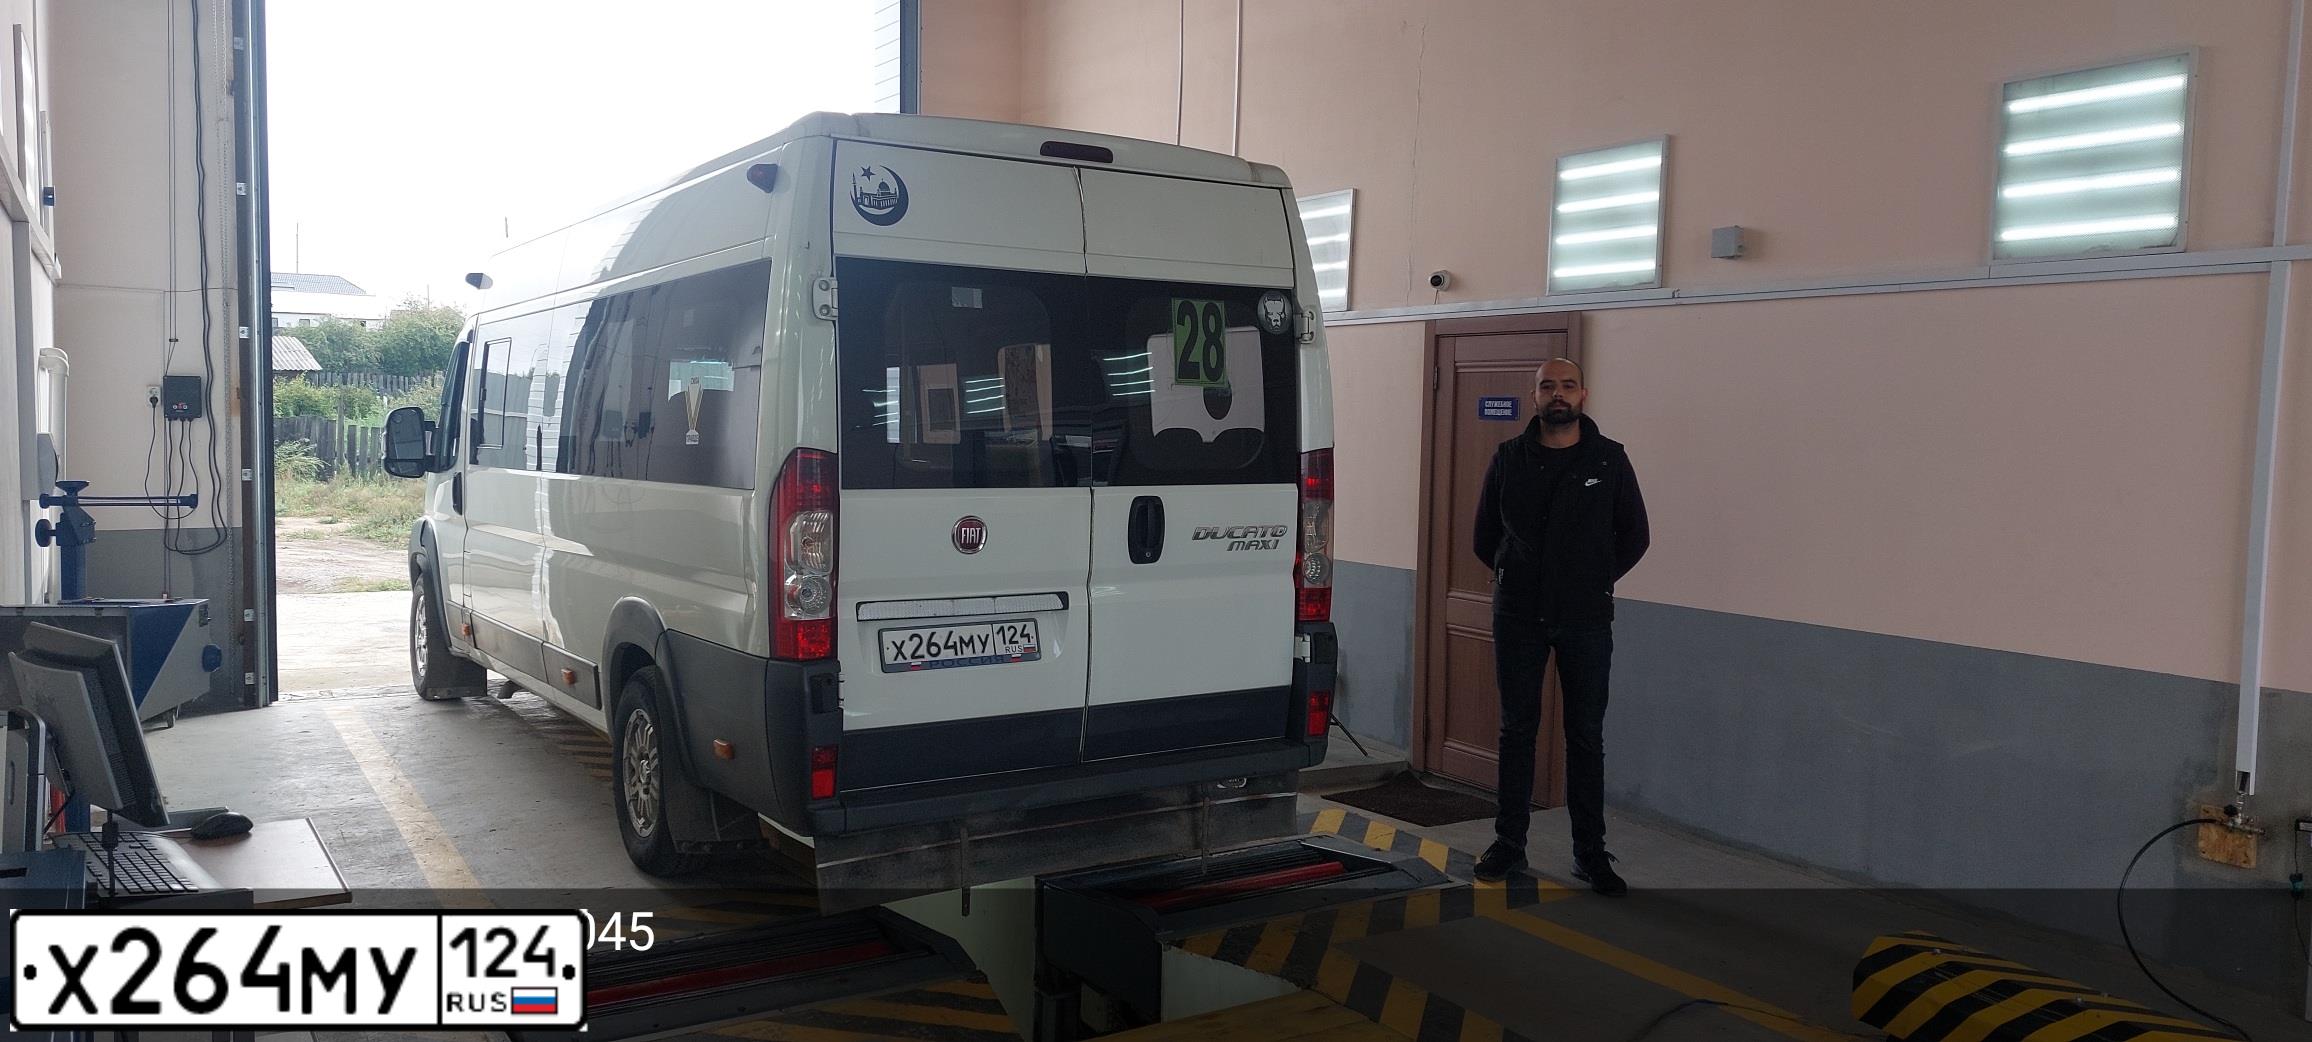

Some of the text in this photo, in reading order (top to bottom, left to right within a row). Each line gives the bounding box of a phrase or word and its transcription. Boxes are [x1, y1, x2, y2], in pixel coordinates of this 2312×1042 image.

[1177, 300, 1224, 382] 28
[961, 527, 982, 544] FIAT
[1192, 525, 1288, 541] DUCATO
[1227, 539, 1280, 551] MAXI
[997, 624, 1031, 646] 124
[1005, 645, 1023, 654] RUS
